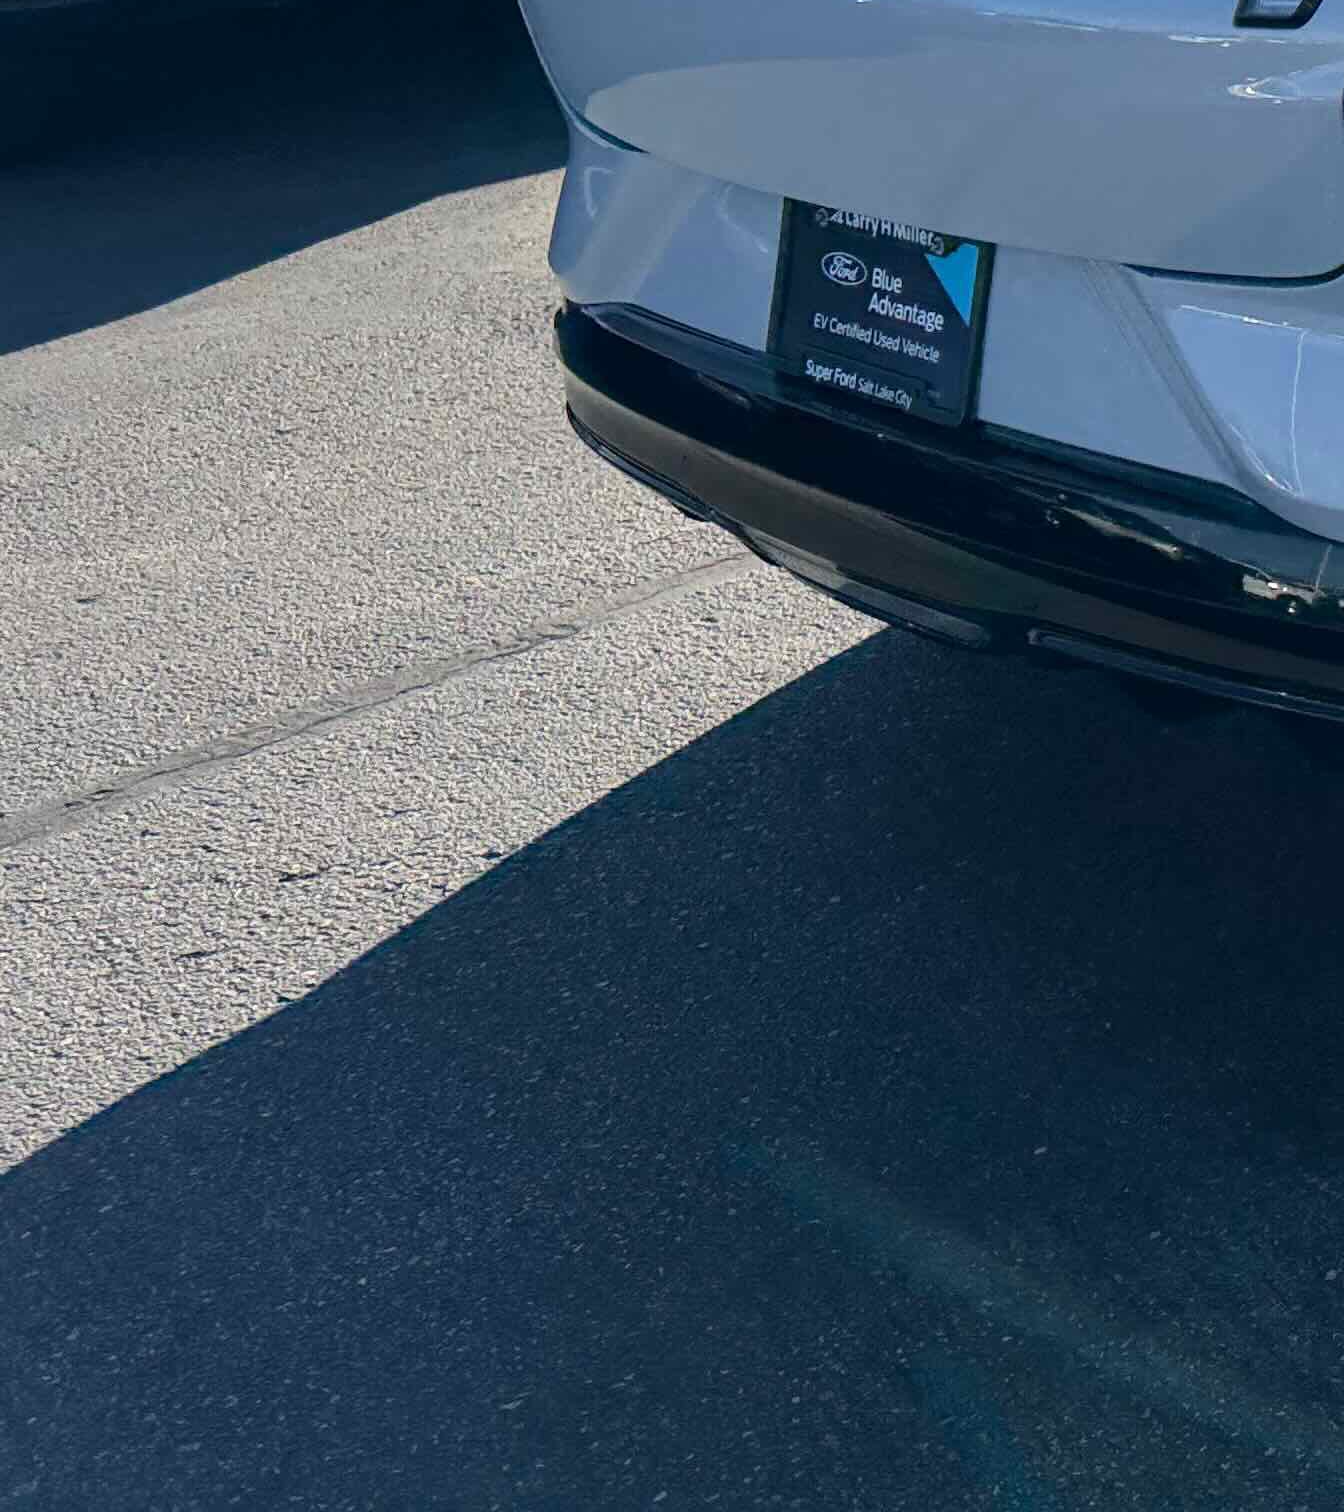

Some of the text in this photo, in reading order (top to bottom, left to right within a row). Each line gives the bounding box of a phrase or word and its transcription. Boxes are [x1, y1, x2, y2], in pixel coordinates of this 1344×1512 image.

[845, 210, 933, 247] Larry H Miller
[829, 255, 860, 283] Ford
[871, 267, 903, 294] Blue
[868, 292, 945, 333] Advantage
[814, 313, 940, 364] EV Certified Used Vehicle
[805, 359, 912, 409] Super Ford Salt Lake City
